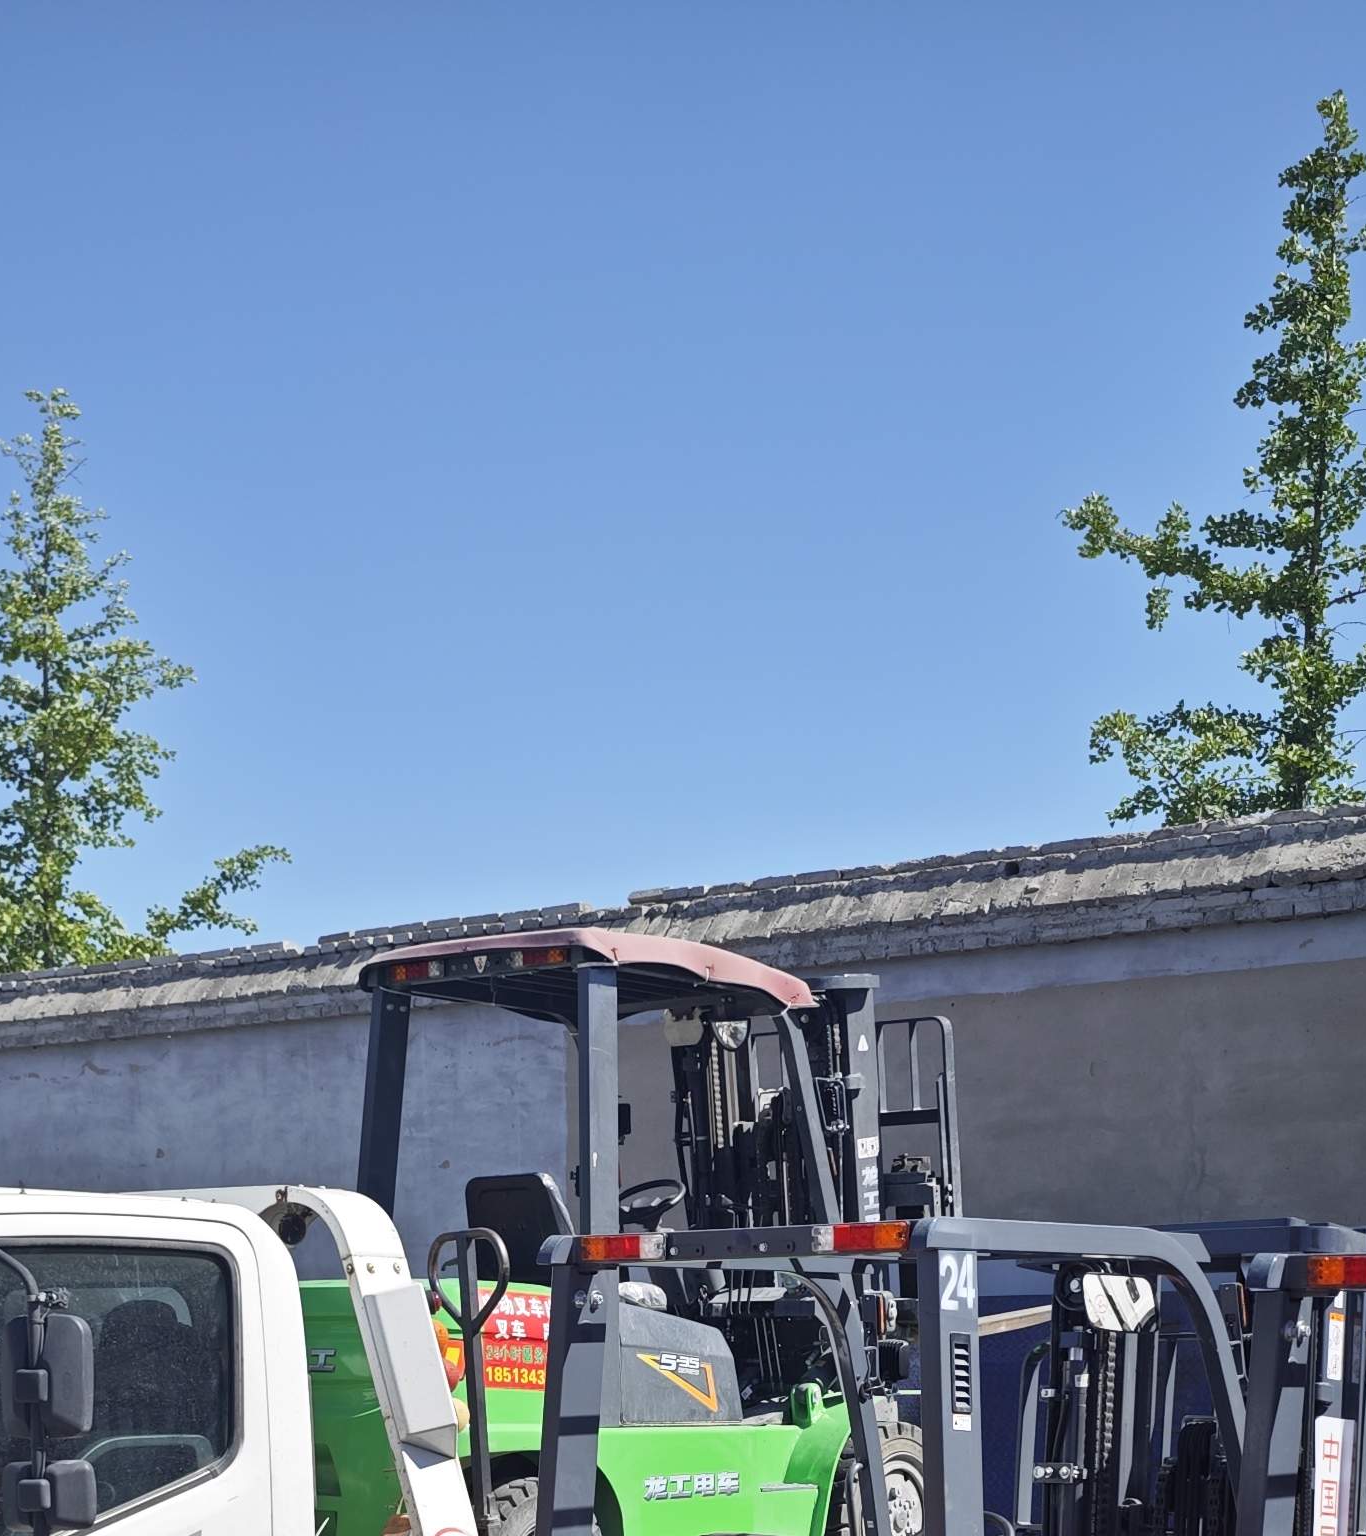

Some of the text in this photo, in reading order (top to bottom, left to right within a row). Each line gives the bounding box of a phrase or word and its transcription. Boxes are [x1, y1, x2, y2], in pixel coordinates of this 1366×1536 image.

[940, 1253, 976, 1311] 24
[643, 1471, 740, 1501] 龙工电车
